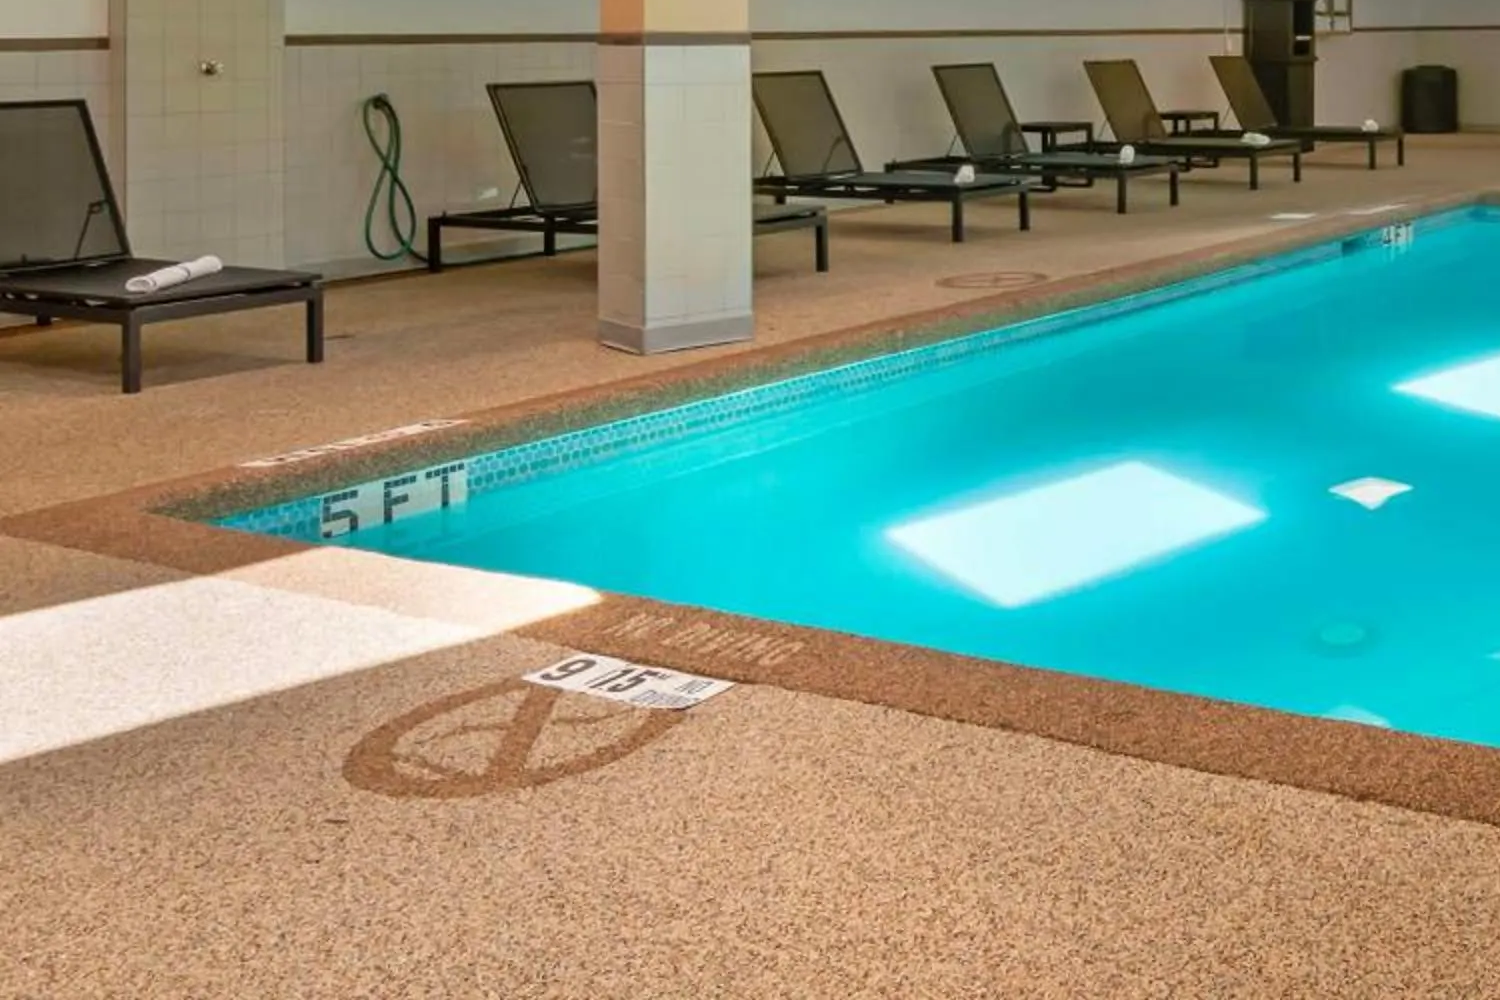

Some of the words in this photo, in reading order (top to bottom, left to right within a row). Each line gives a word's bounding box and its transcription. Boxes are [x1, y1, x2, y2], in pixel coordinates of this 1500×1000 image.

[322, 490, 359, 538] 5
[384, 463, 464, 524] FT
[541, 658, 597, 681] 9
